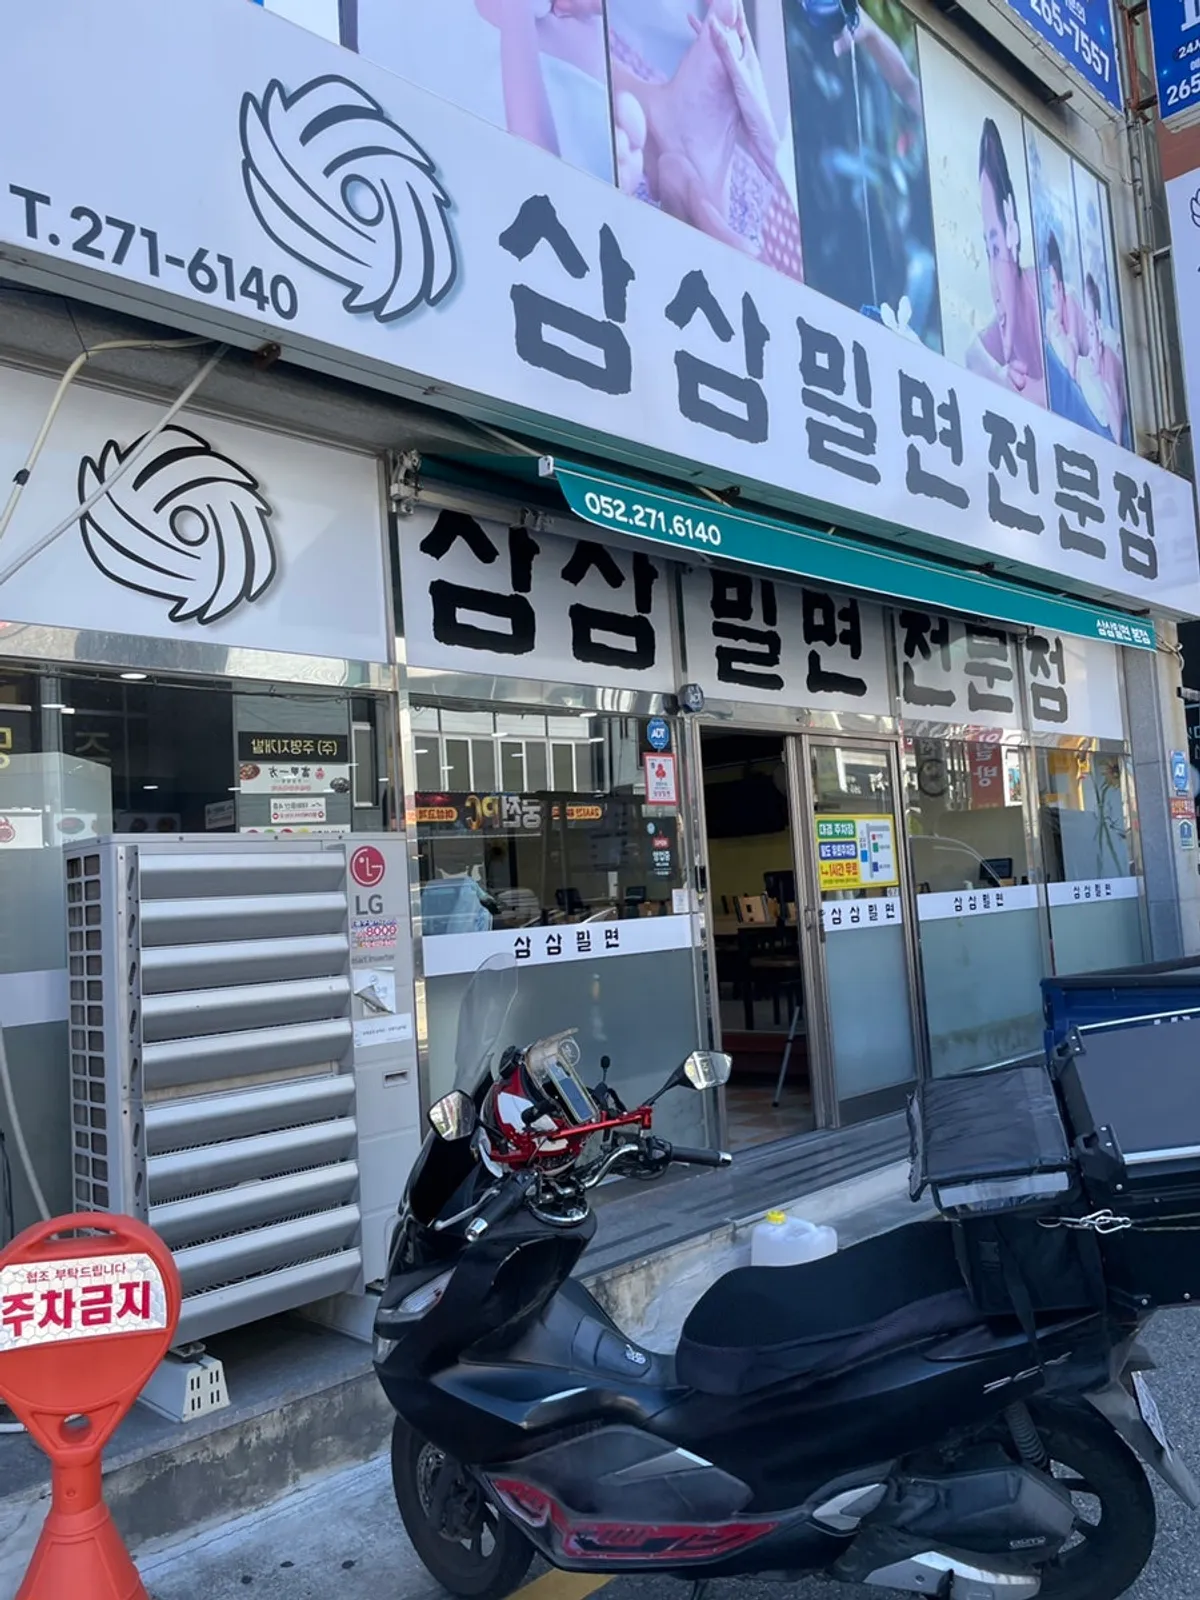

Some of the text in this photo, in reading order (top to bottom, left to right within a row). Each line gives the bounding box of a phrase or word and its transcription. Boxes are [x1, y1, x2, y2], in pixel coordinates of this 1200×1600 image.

[9, 184, 299, 321] T.271-6140
[584, 492, 721, 546] 052.271.6140
[355, 894, 384, 916] LG
[25, 1262, 127, 1284] 협조 부탁드립니다
[2, 1281, 151, 1337] 주차금지
